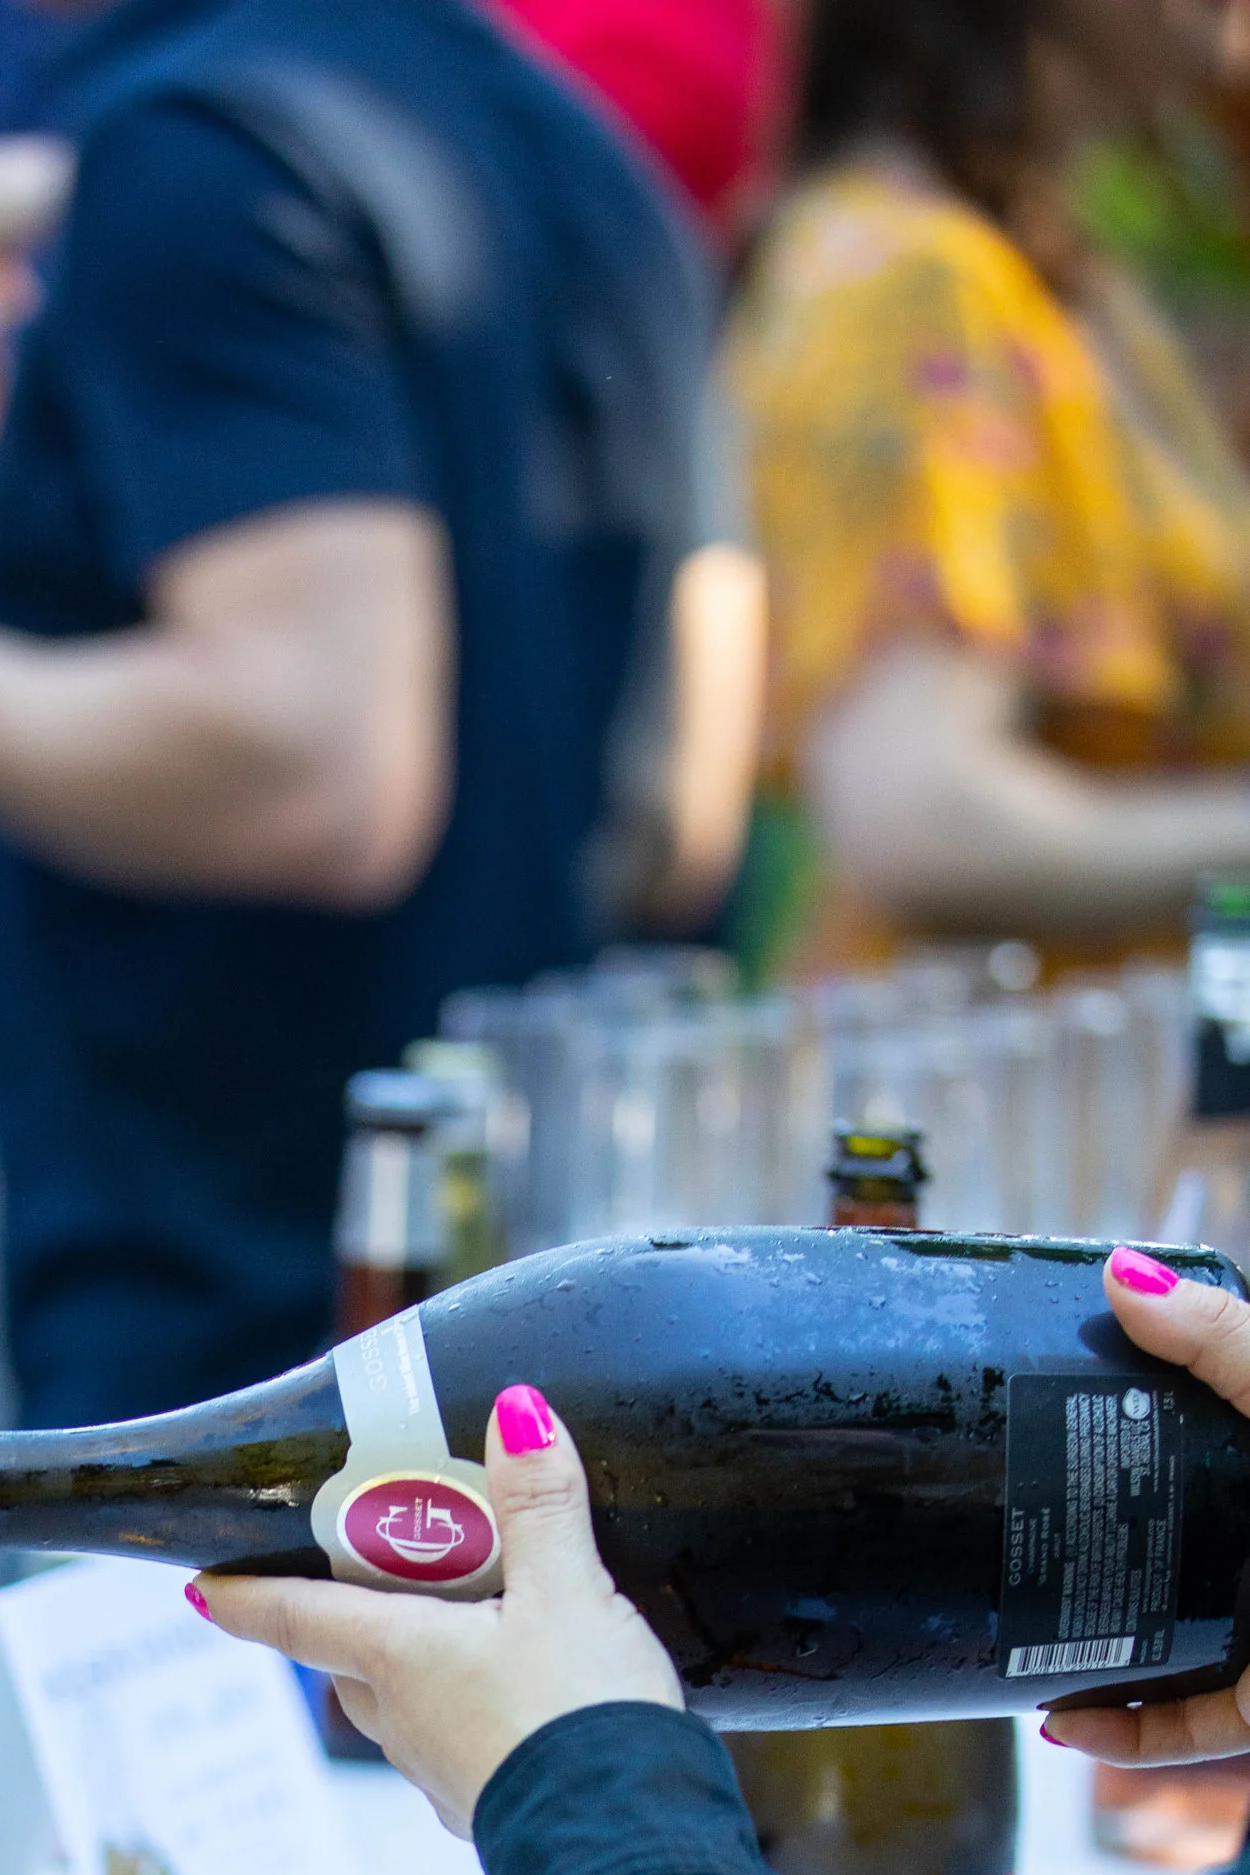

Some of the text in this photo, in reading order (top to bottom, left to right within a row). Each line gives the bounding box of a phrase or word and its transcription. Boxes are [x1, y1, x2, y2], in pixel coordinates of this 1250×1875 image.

[414, 1497, 423, 1540] GOSSET
[1155, 1518, 1167, 1557] FRANCE
[1009, 1507, 1025, 1586] GOSSET
